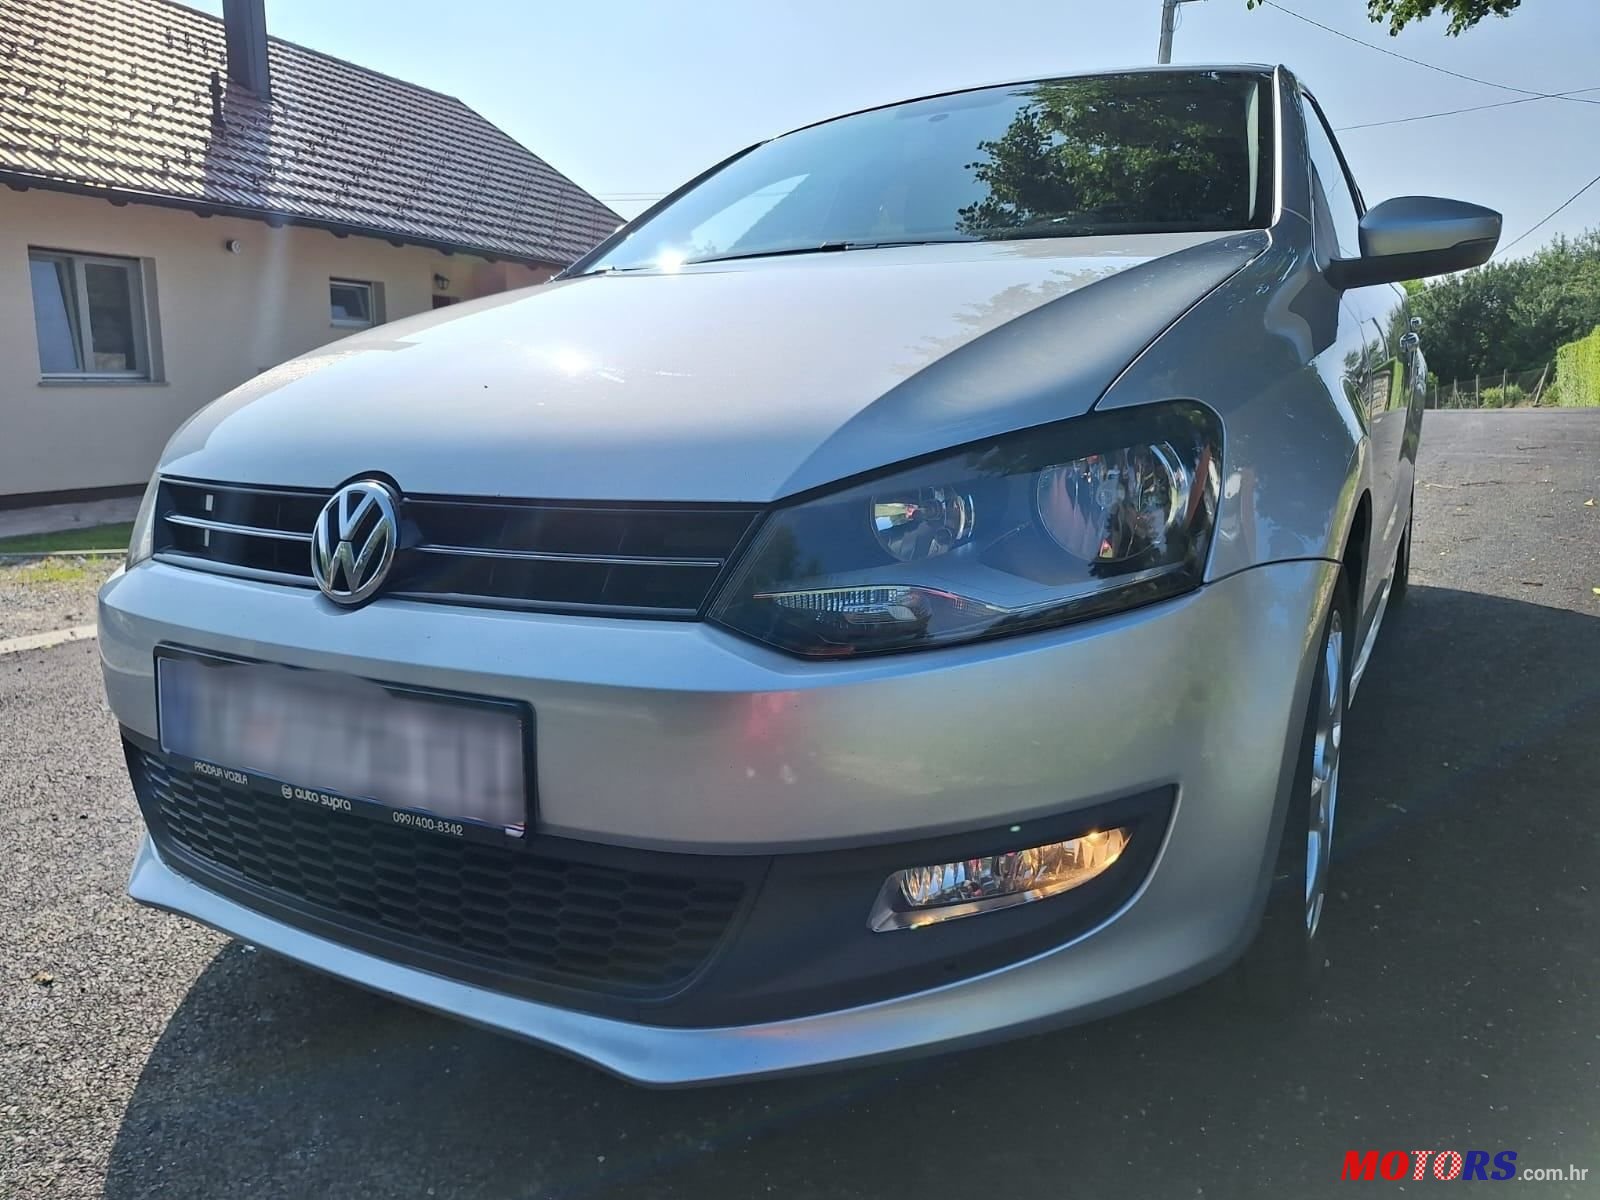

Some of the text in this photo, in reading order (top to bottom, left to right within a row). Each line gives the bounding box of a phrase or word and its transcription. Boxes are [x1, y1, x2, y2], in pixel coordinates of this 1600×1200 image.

[313, 483, 395, 600] VW
[194, 760, 248, 785] PRODAJA VOZILA
[295, 788, 352, 811] auto supra
[392, 811, 464, 836] 099/400-8342
